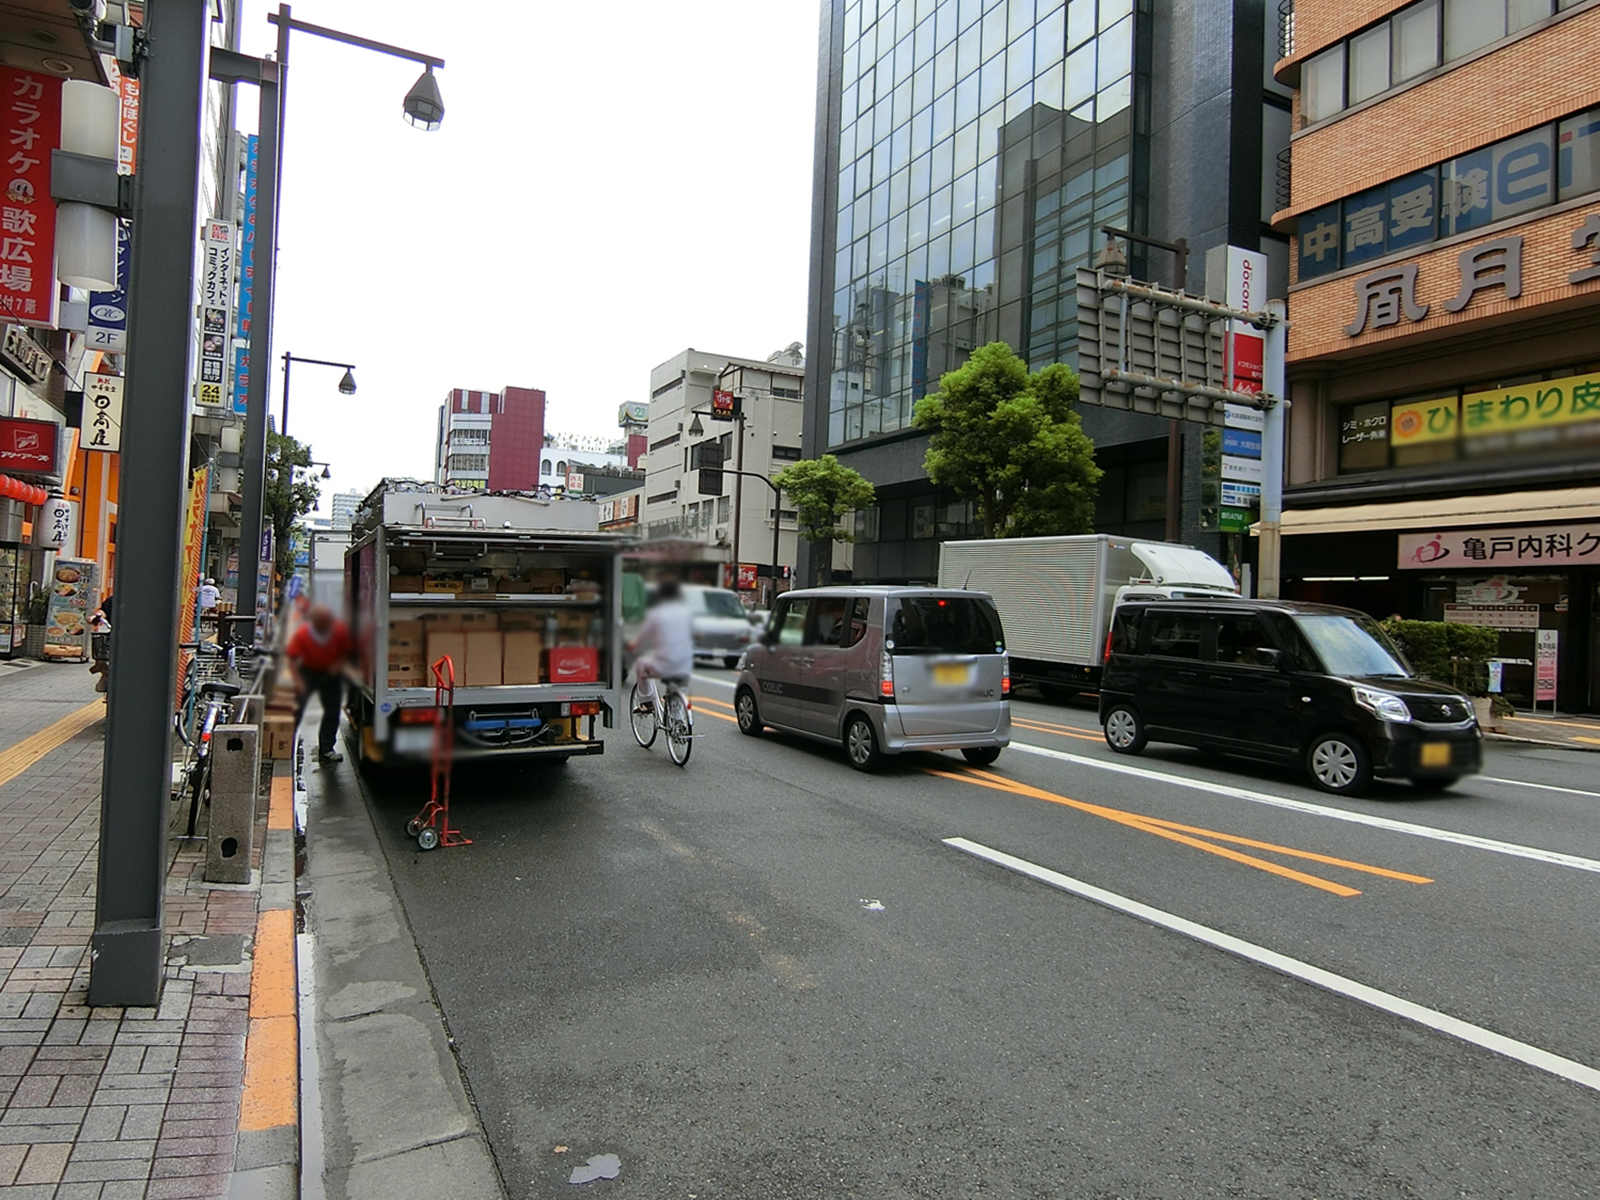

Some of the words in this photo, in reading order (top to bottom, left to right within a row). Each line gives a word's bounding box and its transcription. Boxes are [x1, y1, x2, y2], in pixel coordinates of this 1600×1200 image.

[8, 75, 43, 174] カラオケ
[1303, 165, 1490, 263] 中高受験
[0, 205, 37, 293] 歌広場
[206, 246, 218, 305] コミックカフェ
[95, 330, 118, 345] 2F
[90, 395, 111, 446] 日高屋
[1463, 531, 1600, 561] 亀戸内科ク
